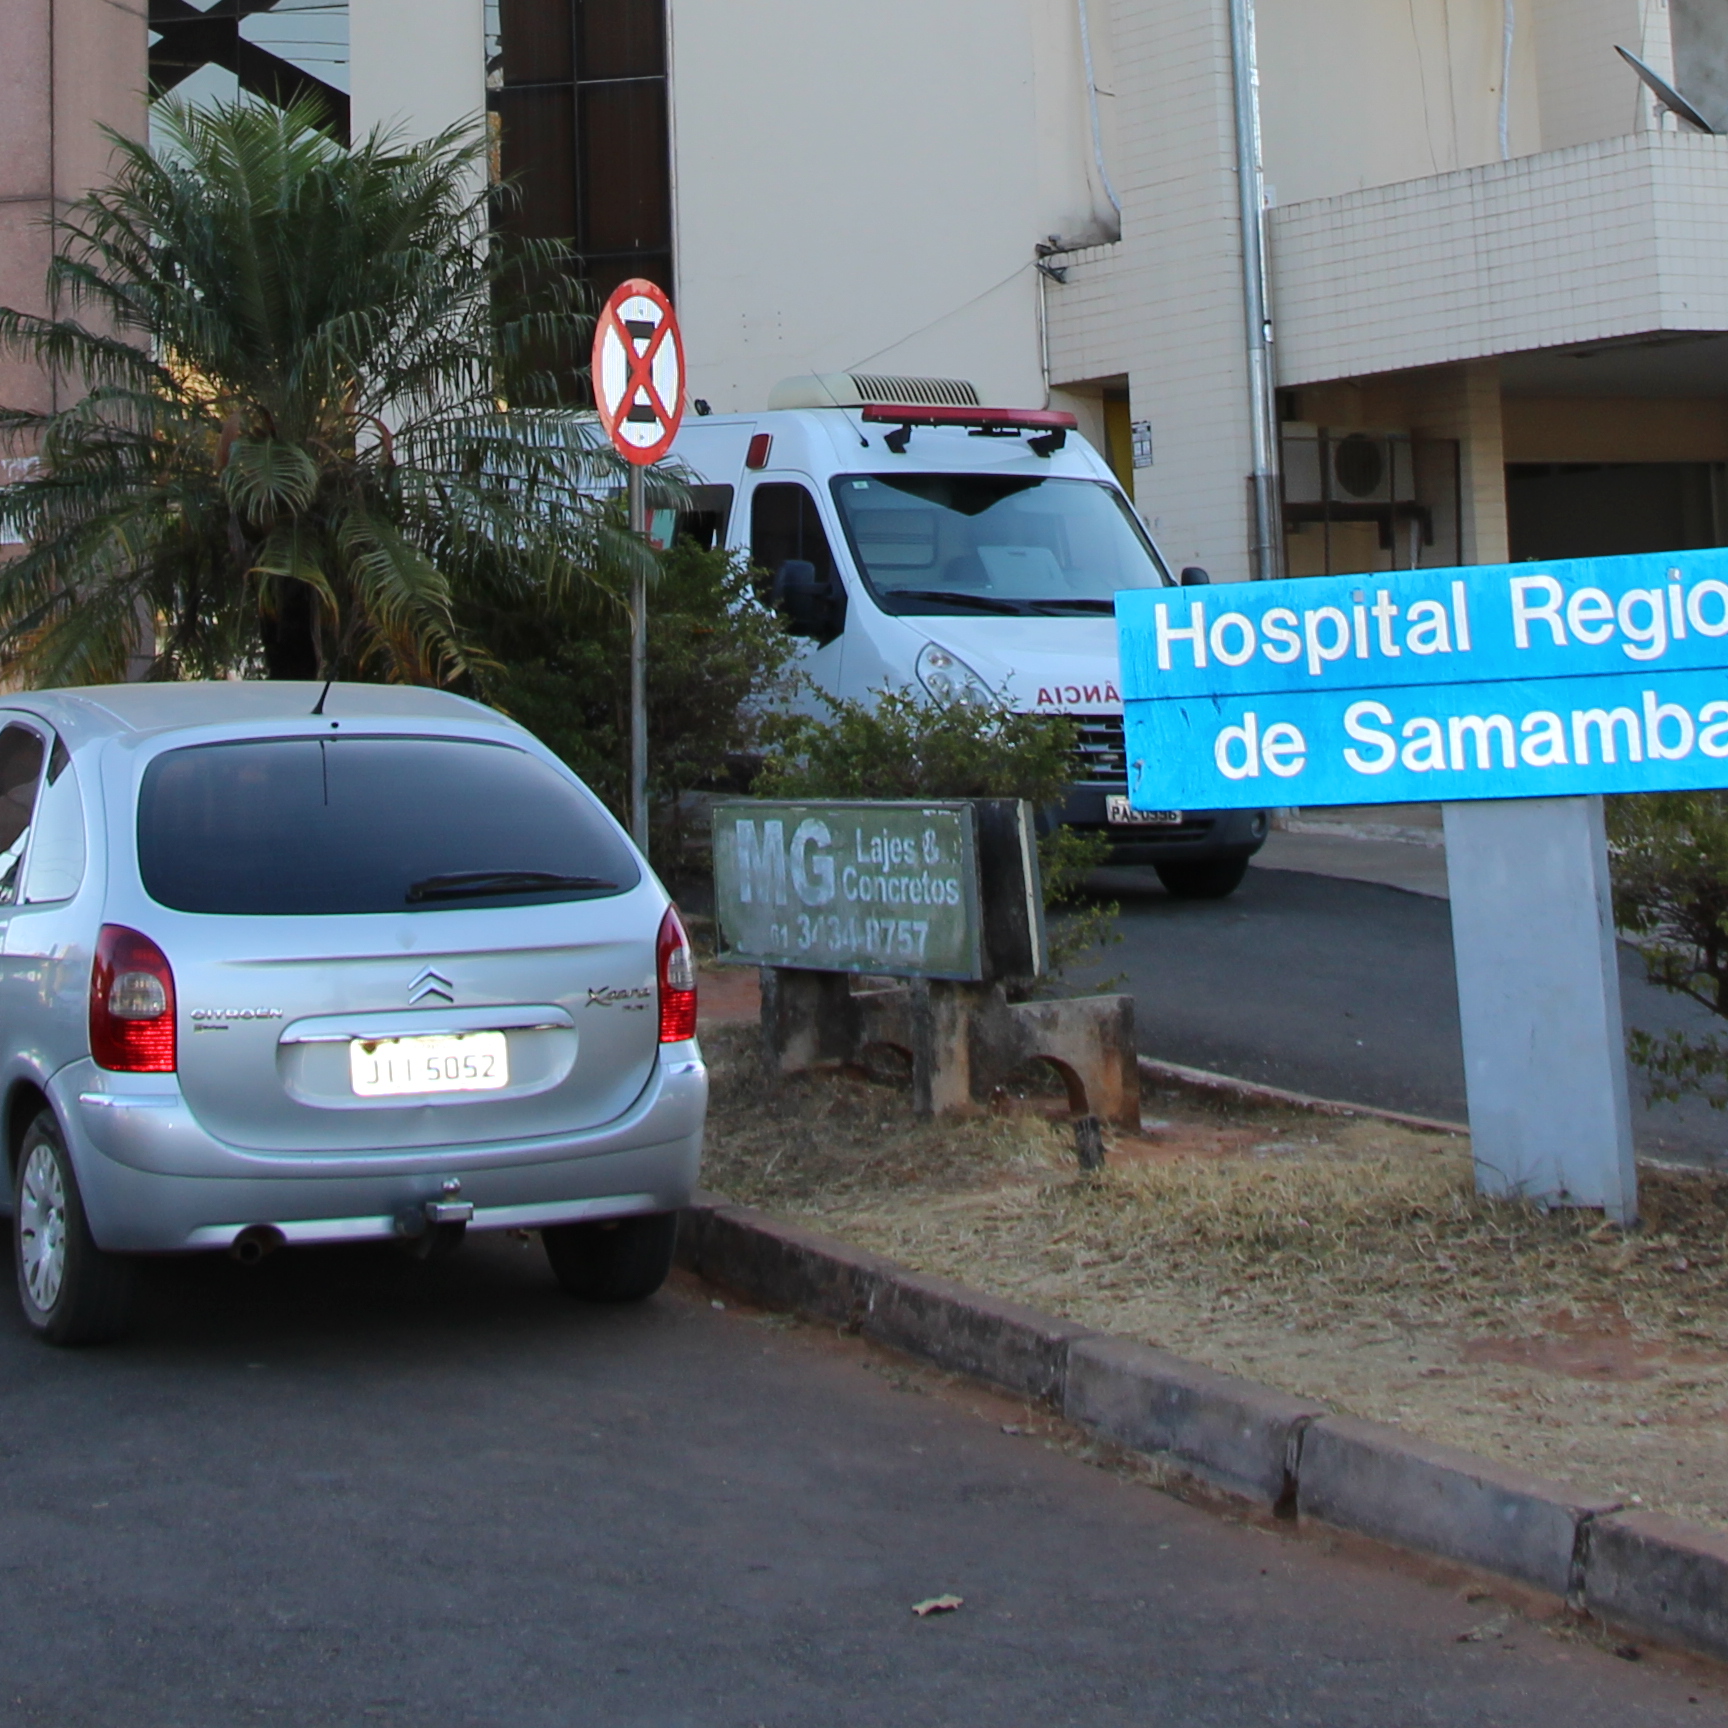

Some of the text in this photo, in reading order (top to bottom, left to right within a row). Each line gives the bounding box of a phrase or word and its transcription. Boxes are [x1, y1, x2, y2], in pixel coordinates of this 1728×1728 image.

[1152, 580, 1471, 675] Hospital
[1213, 712, 1307, 779] de
[735, 818, 836, 907] MG
[856, 828, 940, 872] Lajes &
[842, 865, 961, 905] Concretos
